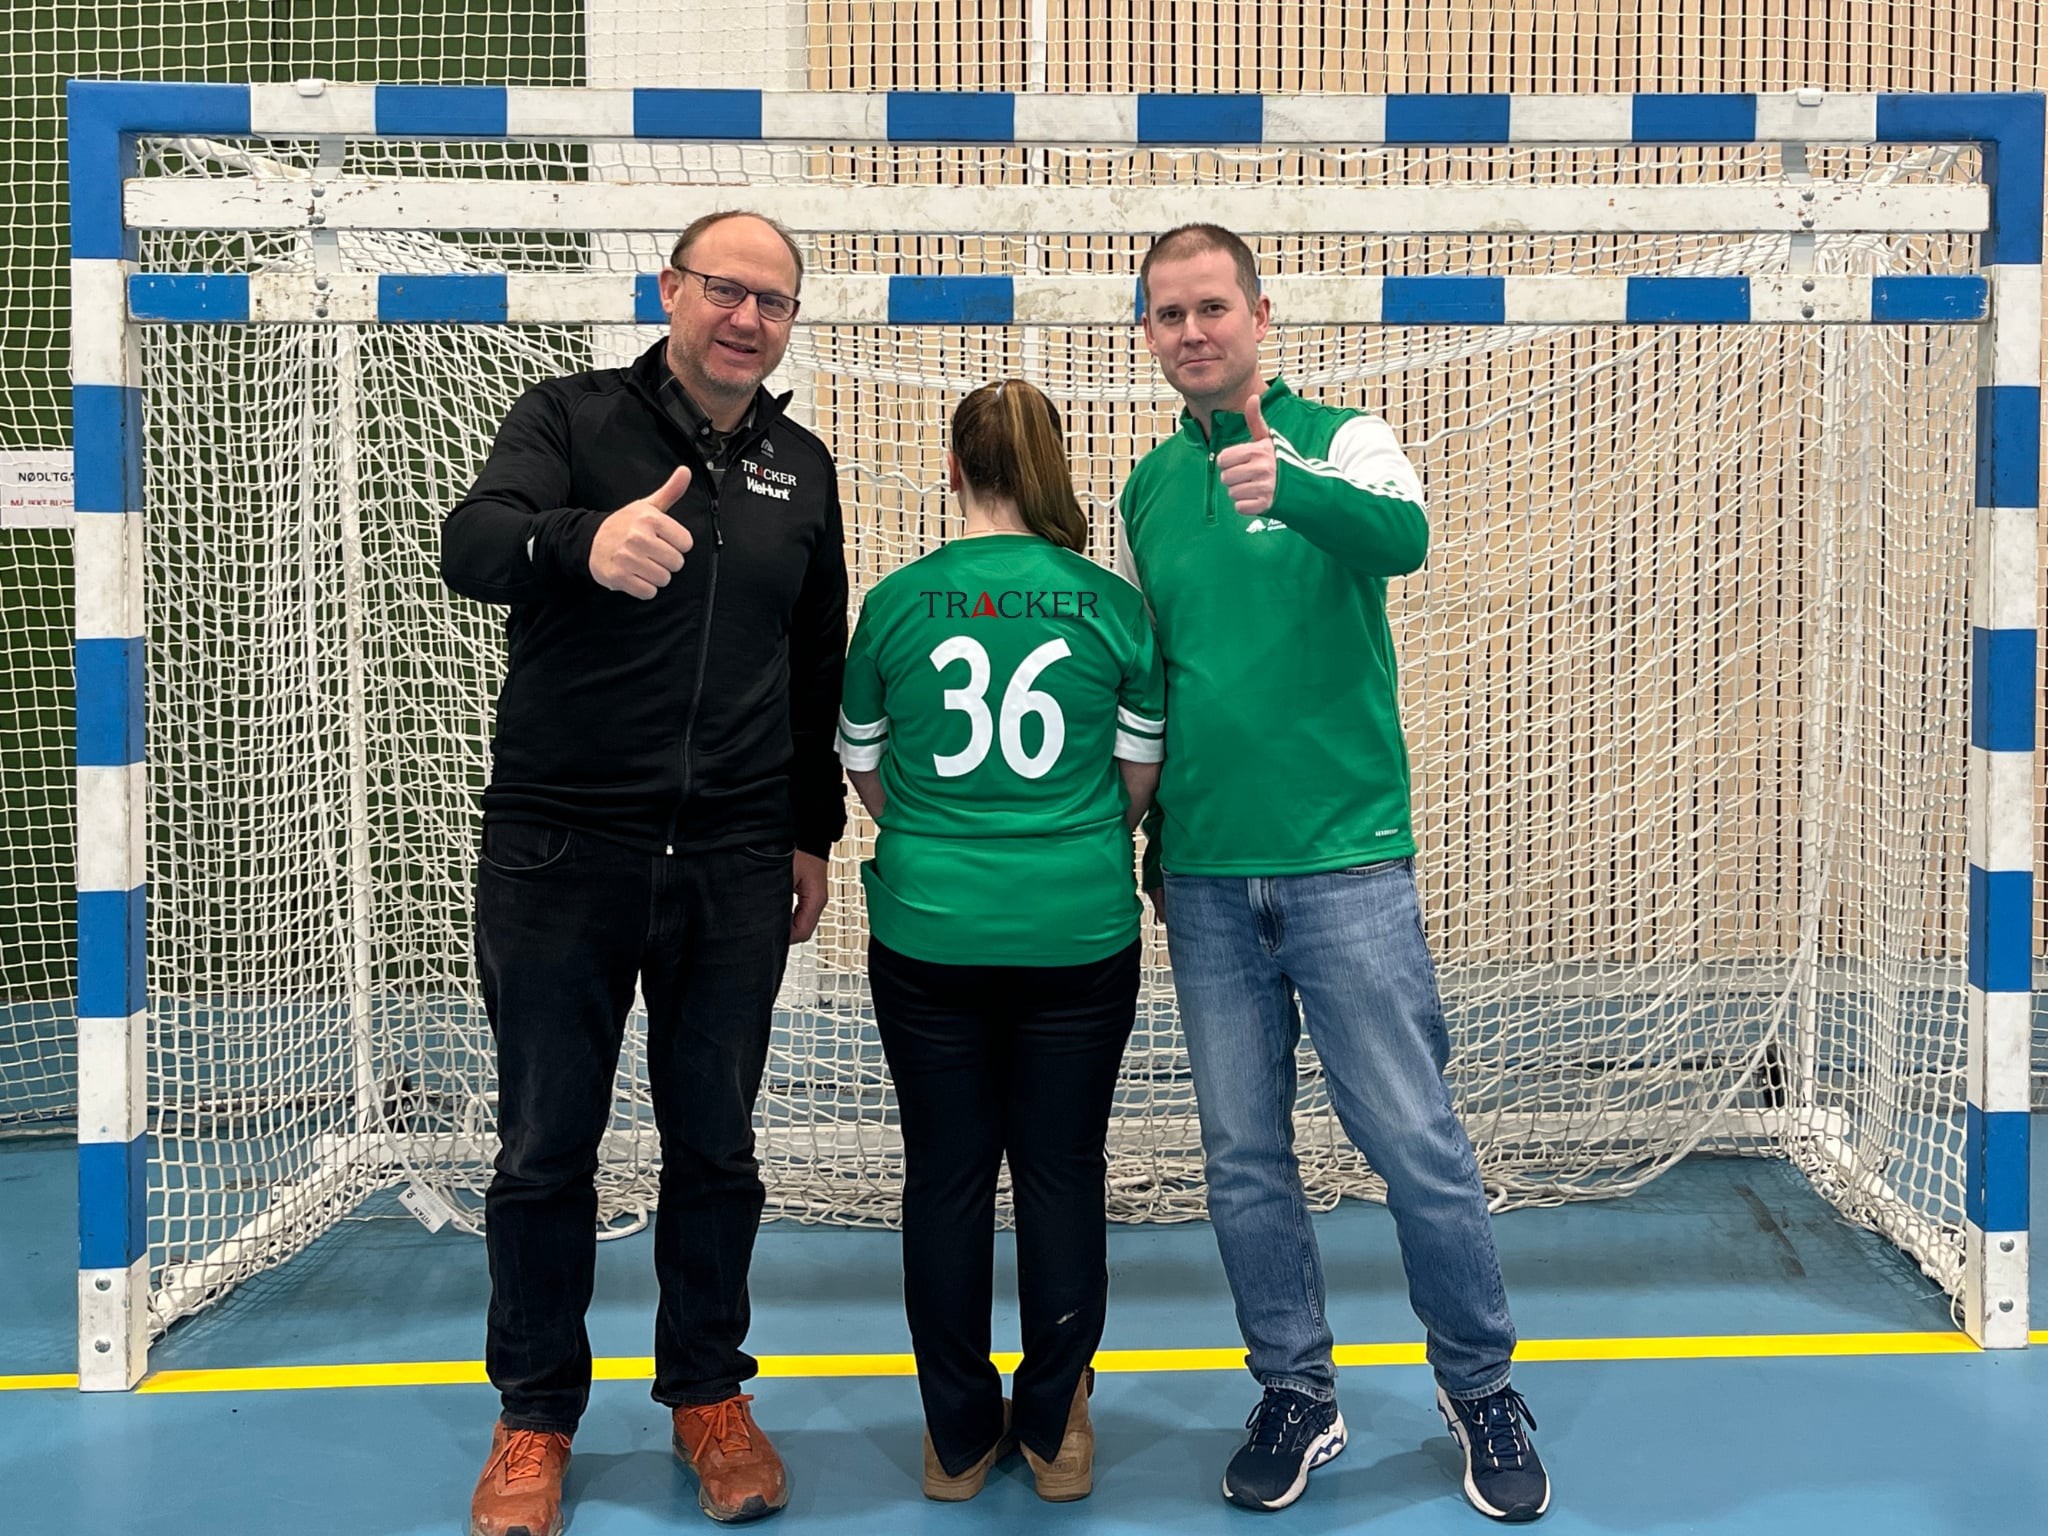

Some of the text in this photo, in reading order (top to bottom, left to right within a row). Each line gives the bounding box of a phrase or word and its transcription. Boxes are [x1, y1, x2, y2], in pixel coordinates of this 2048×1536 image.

[741, 459, 797, 486] TRACKER
[746, 476, 790, 501] WeHunt
[919, 590, 1100, 619] TRACKER
[929, 635, 1072, 779] 36
[412, 1206, 431, 1225] TITAN
